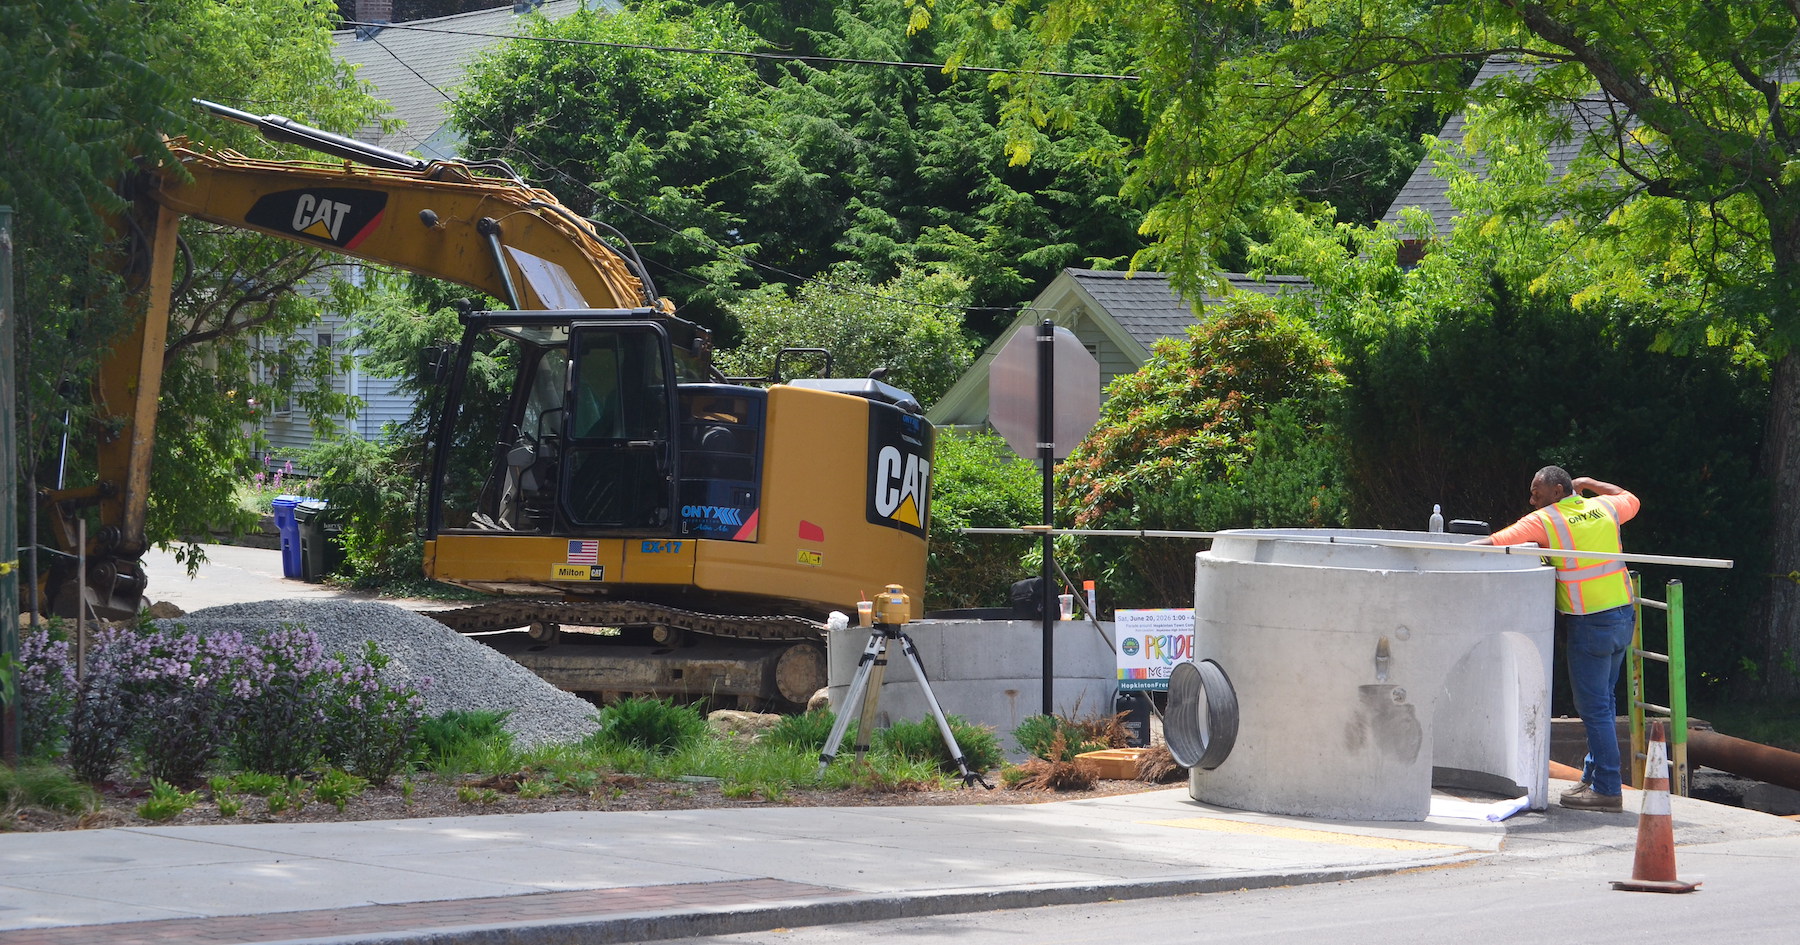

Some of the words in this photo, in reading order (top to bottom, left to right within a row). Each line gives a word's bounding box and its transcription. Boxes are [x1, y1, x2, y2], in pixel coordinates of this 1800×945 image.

[292, 193, 352, 241] CAT
[875, 445, 930, 530] CAT
[681, 505, 728, 524] ONYX
[1568, 509, 1599, 525] ONYX
[641, 541, 683, 554] EX-17
[558, 568, 584, 577] Milton
[591, 569, 602, 577] CAT
[1145, 634, 1194, 666] PRIDE
